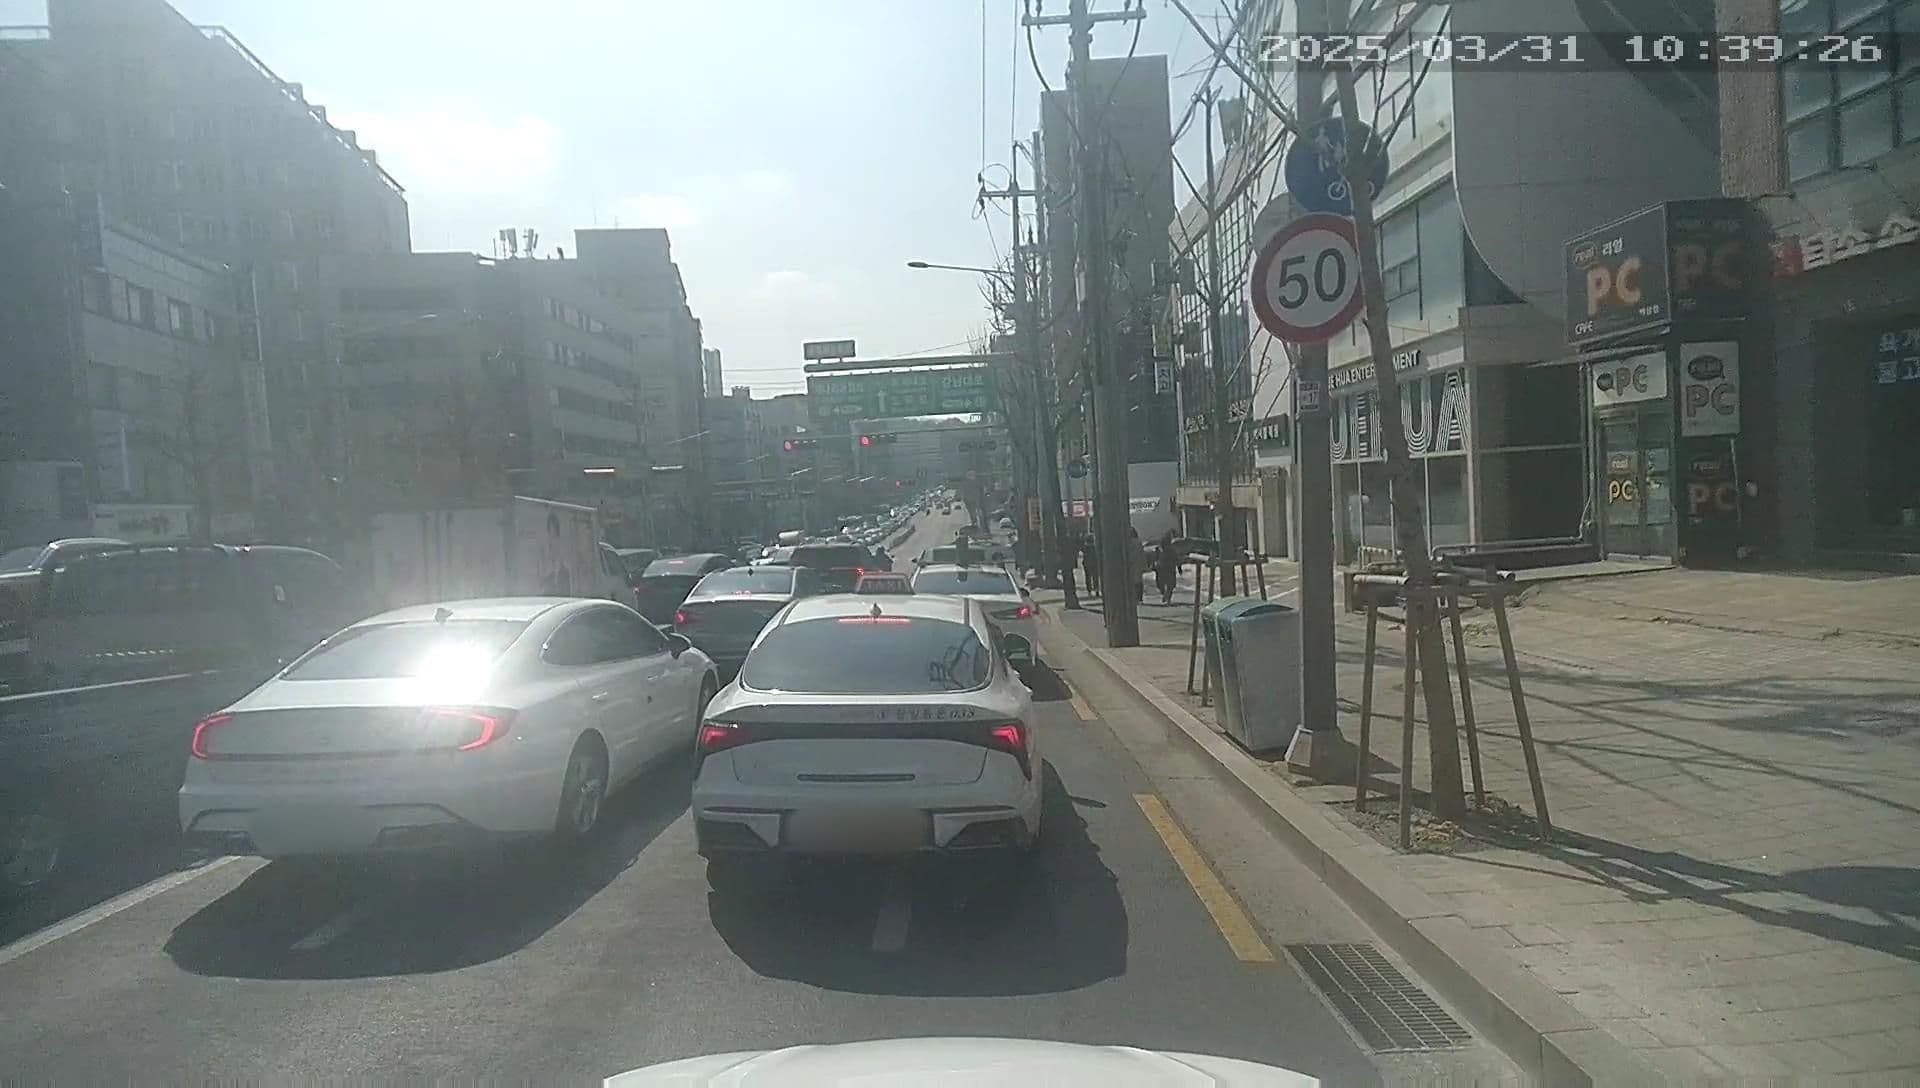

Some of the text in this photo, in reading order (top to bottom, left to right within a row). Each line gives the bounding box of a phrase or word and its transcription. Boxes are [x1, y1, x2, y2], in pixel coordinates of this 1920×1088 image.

[1277, 247, 1346, 309] 50
[1586, 257, 1641, 318] PC
[1615, 363, 1649, 397] PC
[1686, 382, 1736, 418] PC
[1608, 479, 1633, 504] PC
